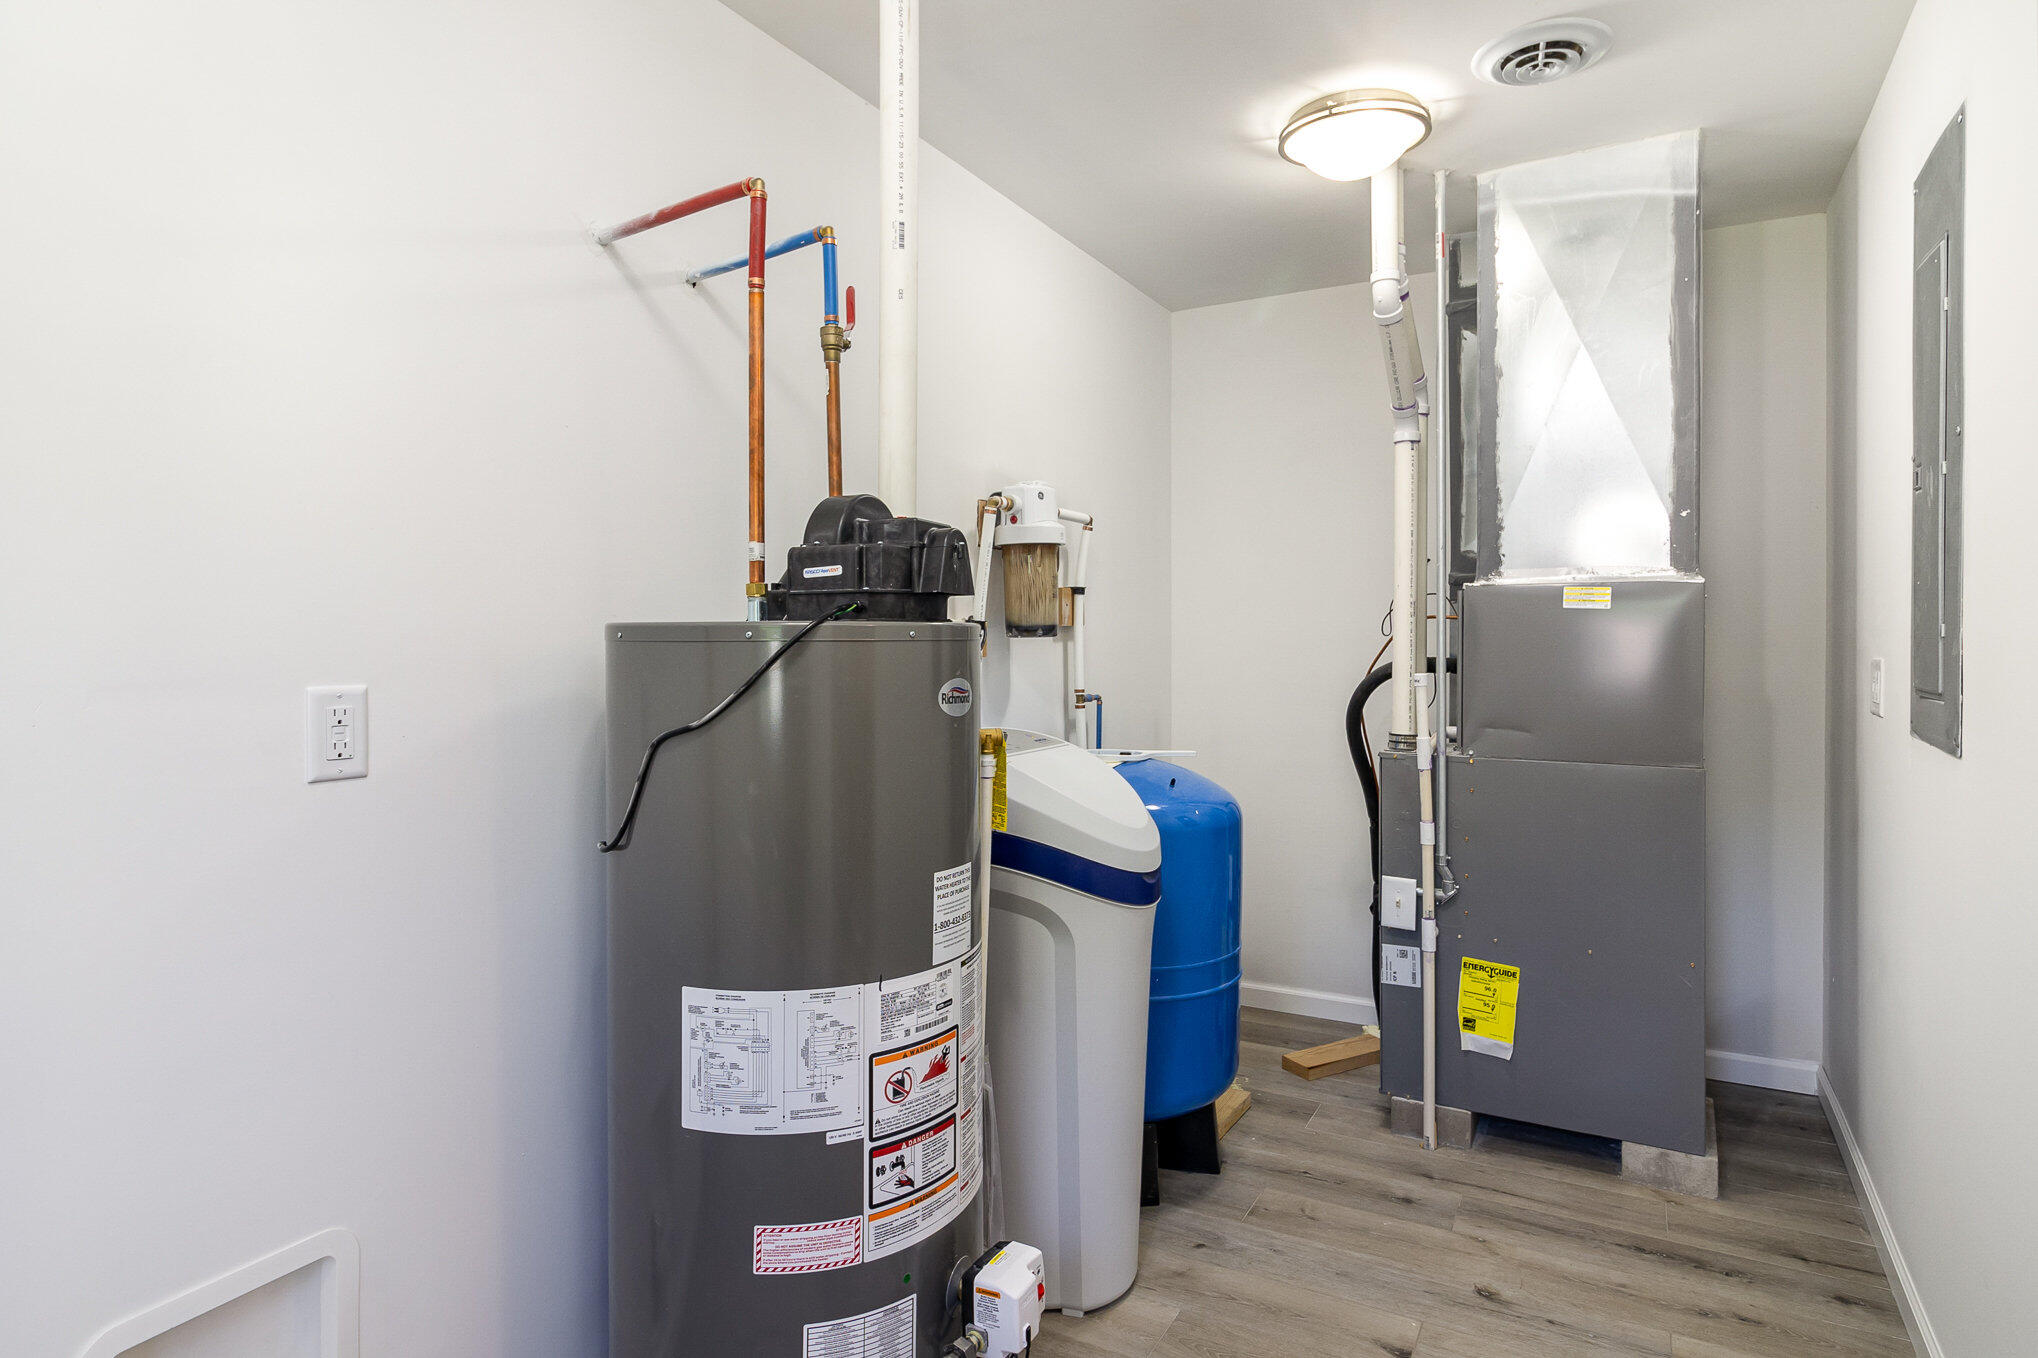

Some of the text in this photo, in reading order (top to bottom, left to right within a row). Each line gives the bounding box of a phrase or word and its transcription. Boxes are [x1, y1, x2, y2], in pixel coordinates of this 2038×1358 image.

[941, 691, 970, 705] Richmond
[1463, 962, 1517, 978] ENERGYGUIDE
[910, 1041, 939, 1055] WARNING
[908, 1130, 934, 1146] DANGER
